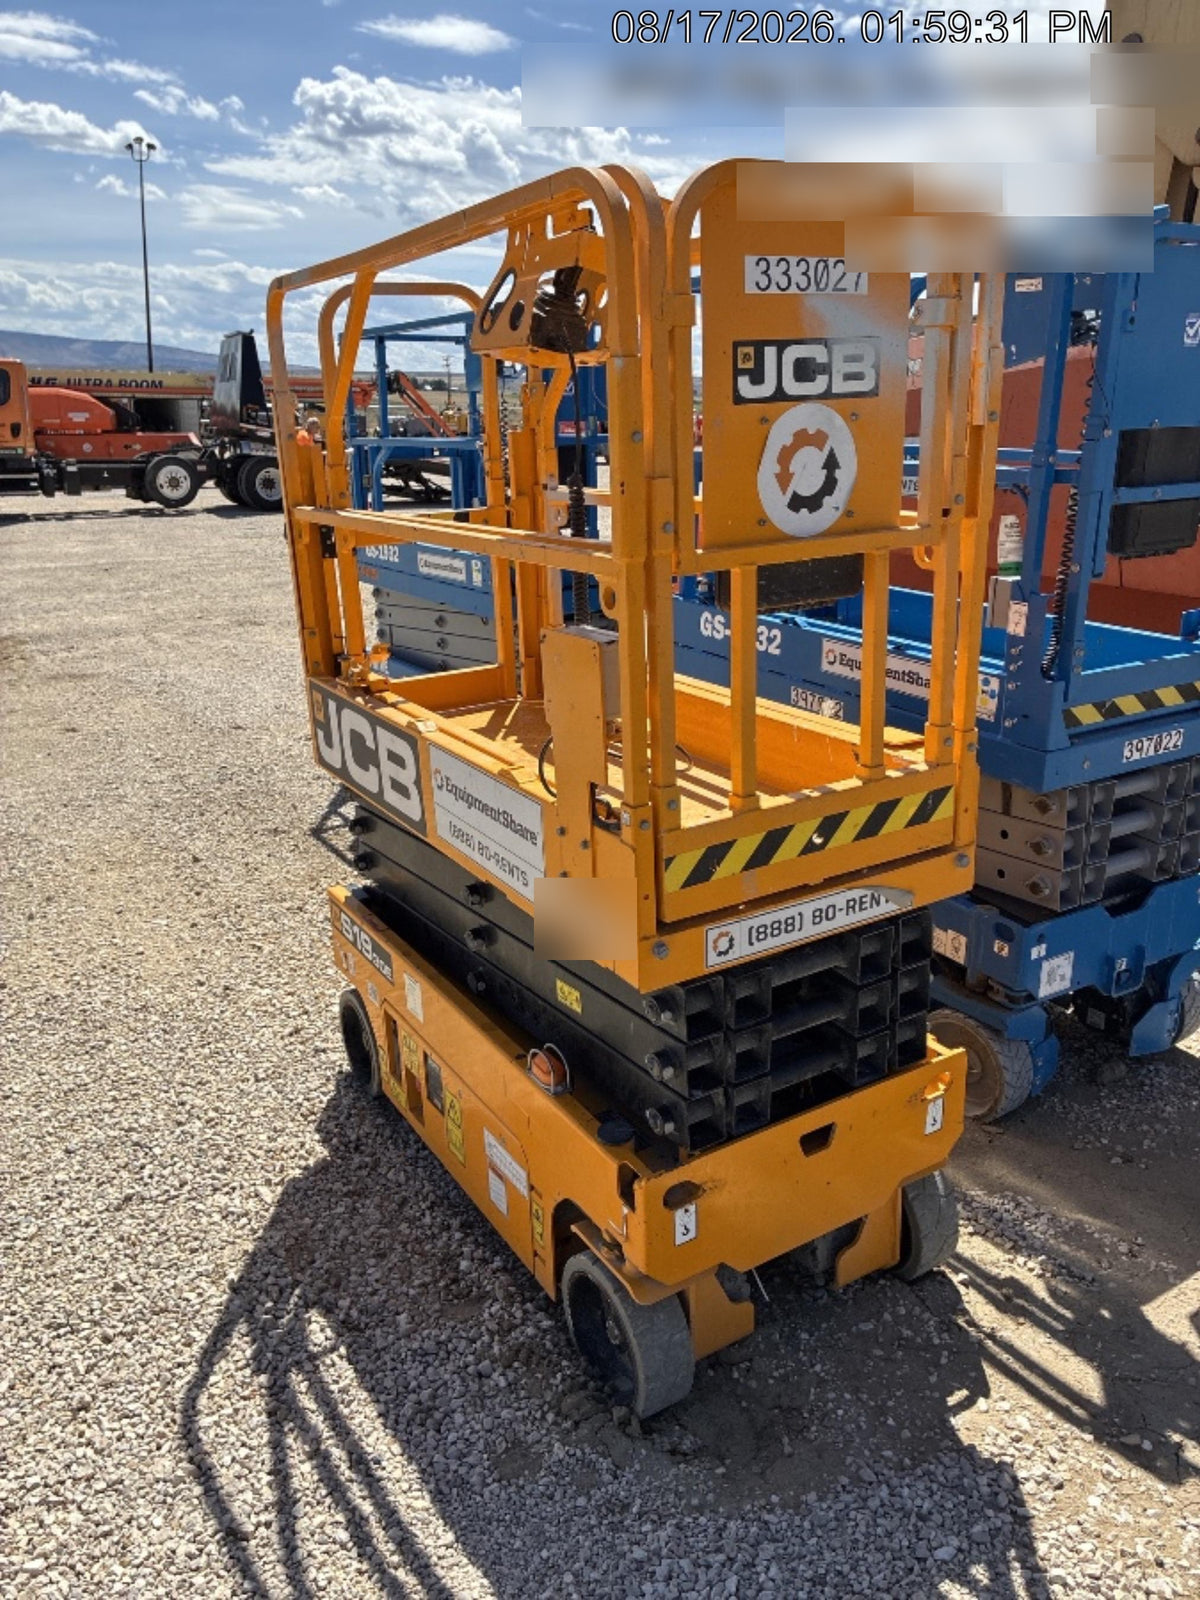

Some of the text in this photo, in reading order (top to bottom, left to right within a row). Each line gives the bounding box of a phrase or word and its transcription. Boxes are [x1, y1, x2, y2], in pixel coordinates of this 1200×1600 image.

[737, 343, 877, 399] JCB
[700, 611, 782, 655] GS-32
[316, 698, 422, 822] JCB
[444, 774, 538, 847] EquipmentShare
[747, 912, 804, 947] (888)
